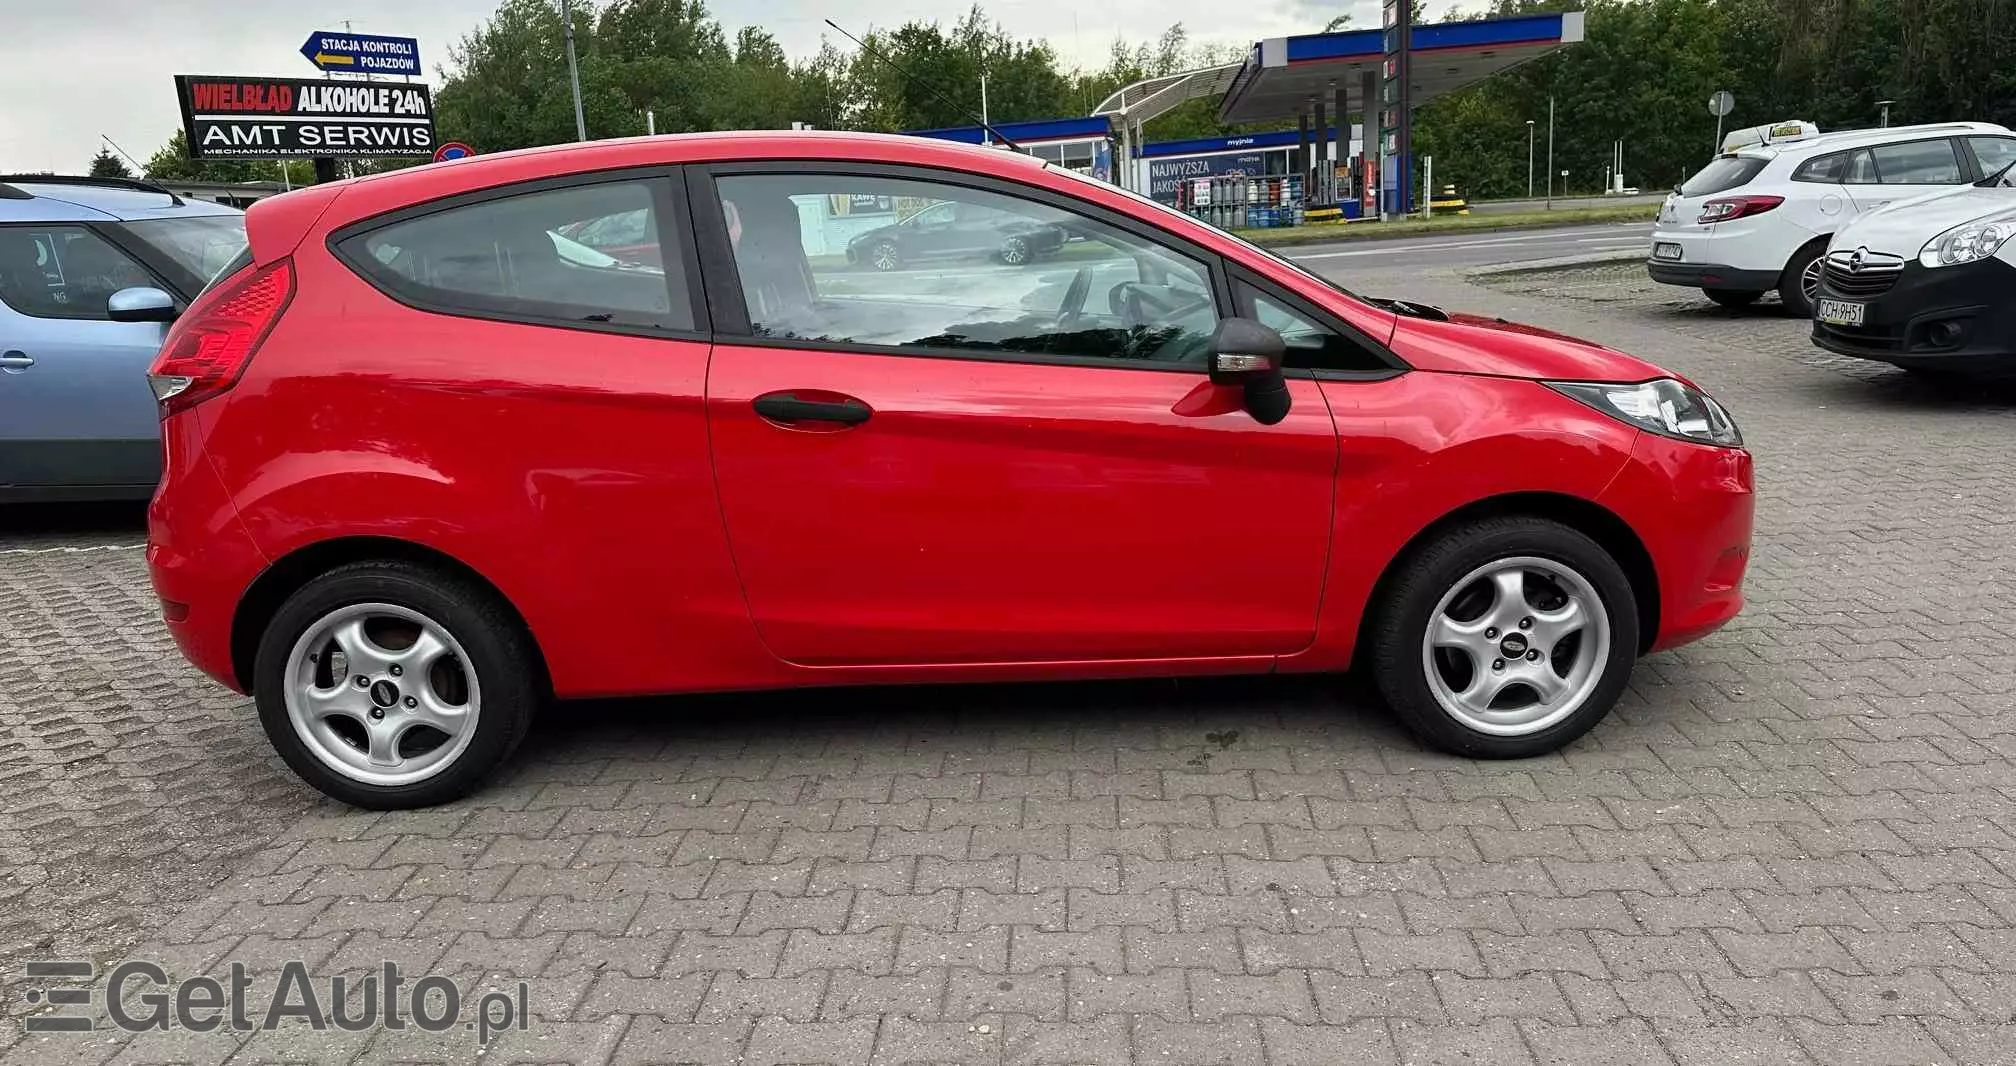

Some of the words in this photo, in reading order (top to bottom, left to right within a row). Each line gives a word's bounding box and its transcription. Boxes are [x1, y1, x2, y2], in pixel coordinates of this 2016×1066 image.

[321, 38, 361, 52] STACJA
[362, 41, 412, 55] KONTROLI
[360, 56, 414, 69] POJAZDÓW
[297, 86, 390, 113] ALKOHOLE
[391, 89, 426, 115] 24h
[202, 125, 286, 145] AMT
[298, 126, 431, 146] SERWIS
[1152, 160, 1210, 178] NAJWYŻSZA
[1152, 176, 1186, 194] JAKOŚ
